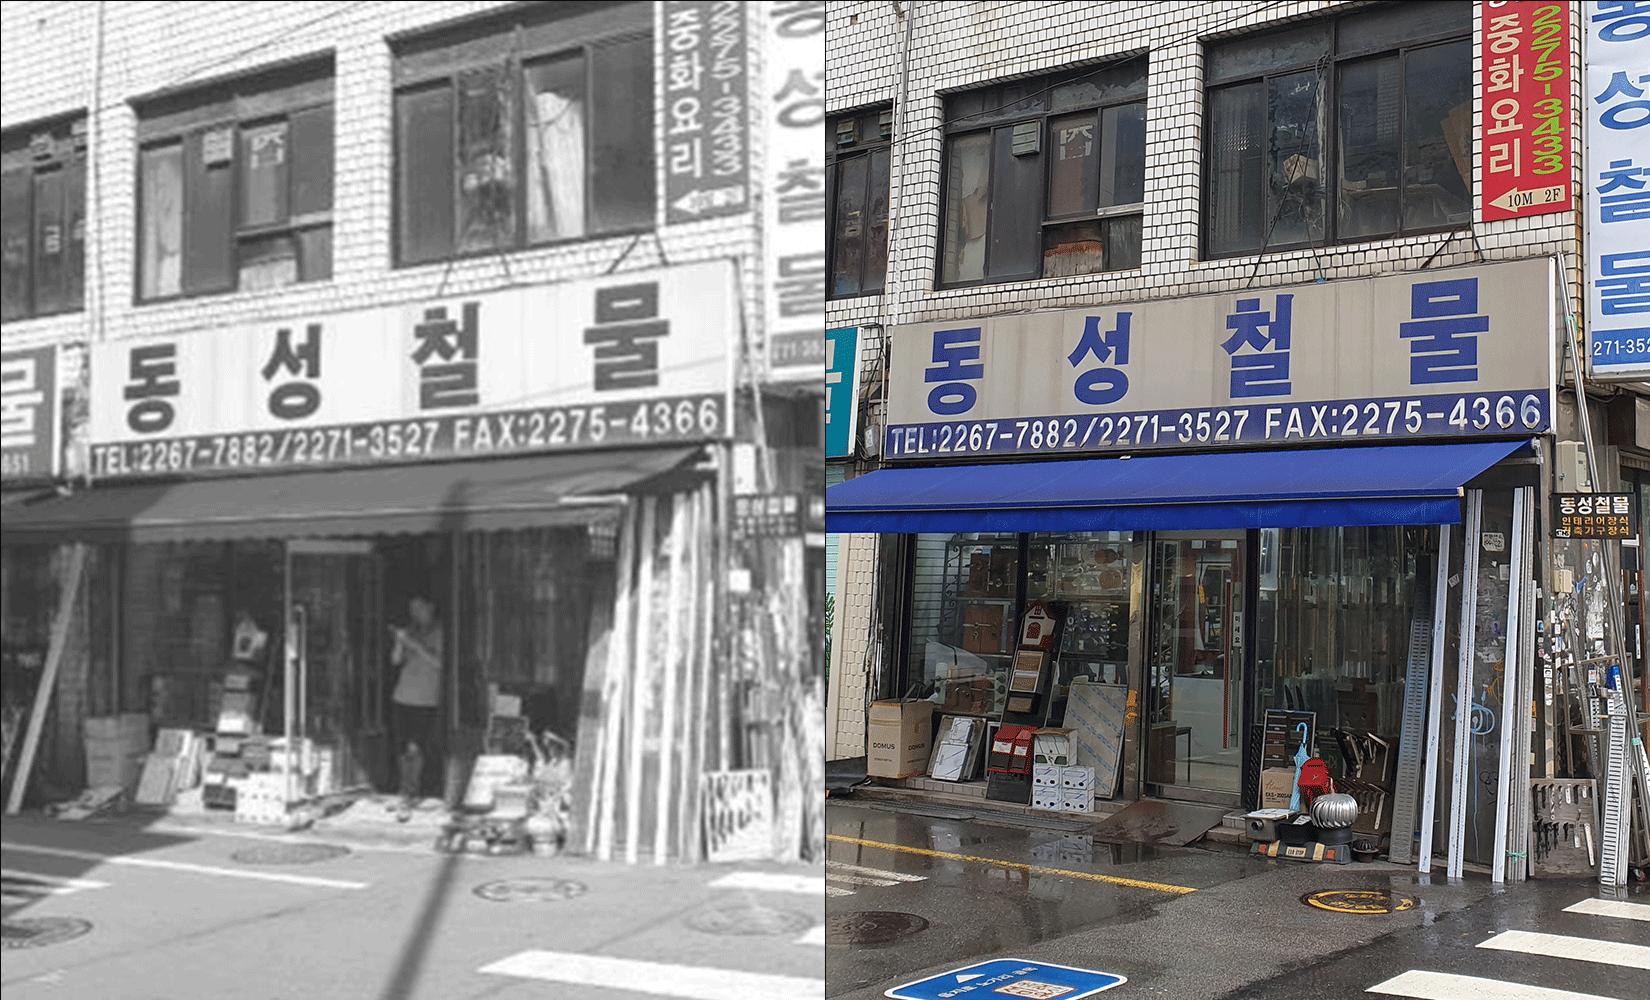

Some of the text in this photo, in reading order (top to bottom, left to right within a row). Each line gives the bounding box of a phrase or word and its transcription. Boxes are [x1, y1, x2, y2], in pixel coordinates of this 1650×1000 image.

[668, 8, 704, 178] 중화요리
[1487, 13, 1524, 177] 중화요리
[1530, 5, 1564, 175] 2275-3433
[1508, 188, 1561, 207] 10M 2F
[123, 281, 670, 434] 동성철물
[924, 277, 1490, 416] 동성철물
[454, 398, 718, 451] FAX:2275-4366
[891, 394, 1541, 455] TEL:2267-7882/2271-3527 FAX:2275-4366
[1560, 496, 1630, 515] 동성철물
[873, 742, 895, 750] DOMUS
